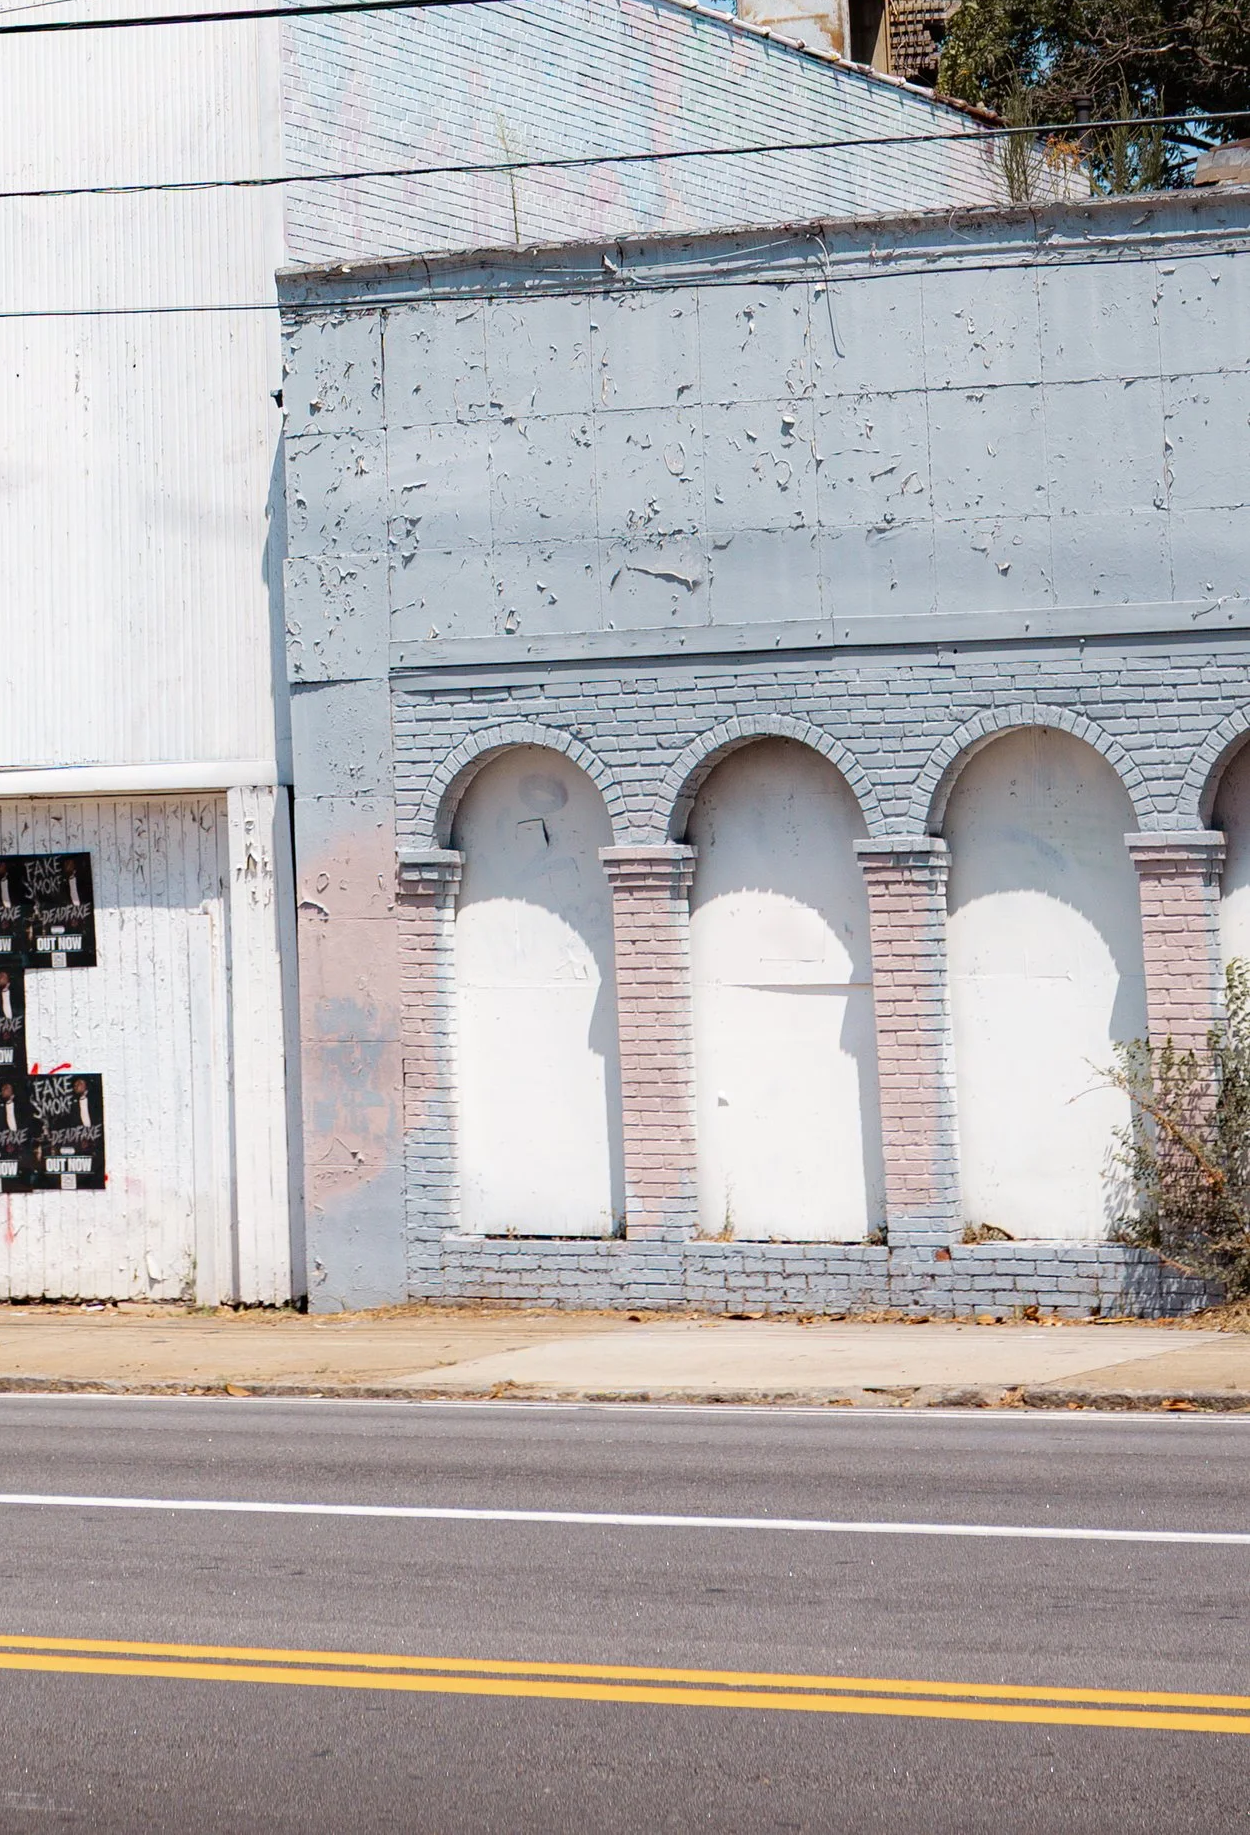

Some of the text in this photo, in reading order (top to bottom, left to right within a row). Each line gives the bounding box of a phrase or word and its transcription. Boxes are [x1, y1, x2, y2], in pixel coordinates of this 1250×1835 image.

[24, 856, 62, 880] FAKE
[37, 936, 82, 951] OUT NOW
[34, 1075, 73, 1098] FAKE
[46, 1157, 92, 1172] OUT NOW
